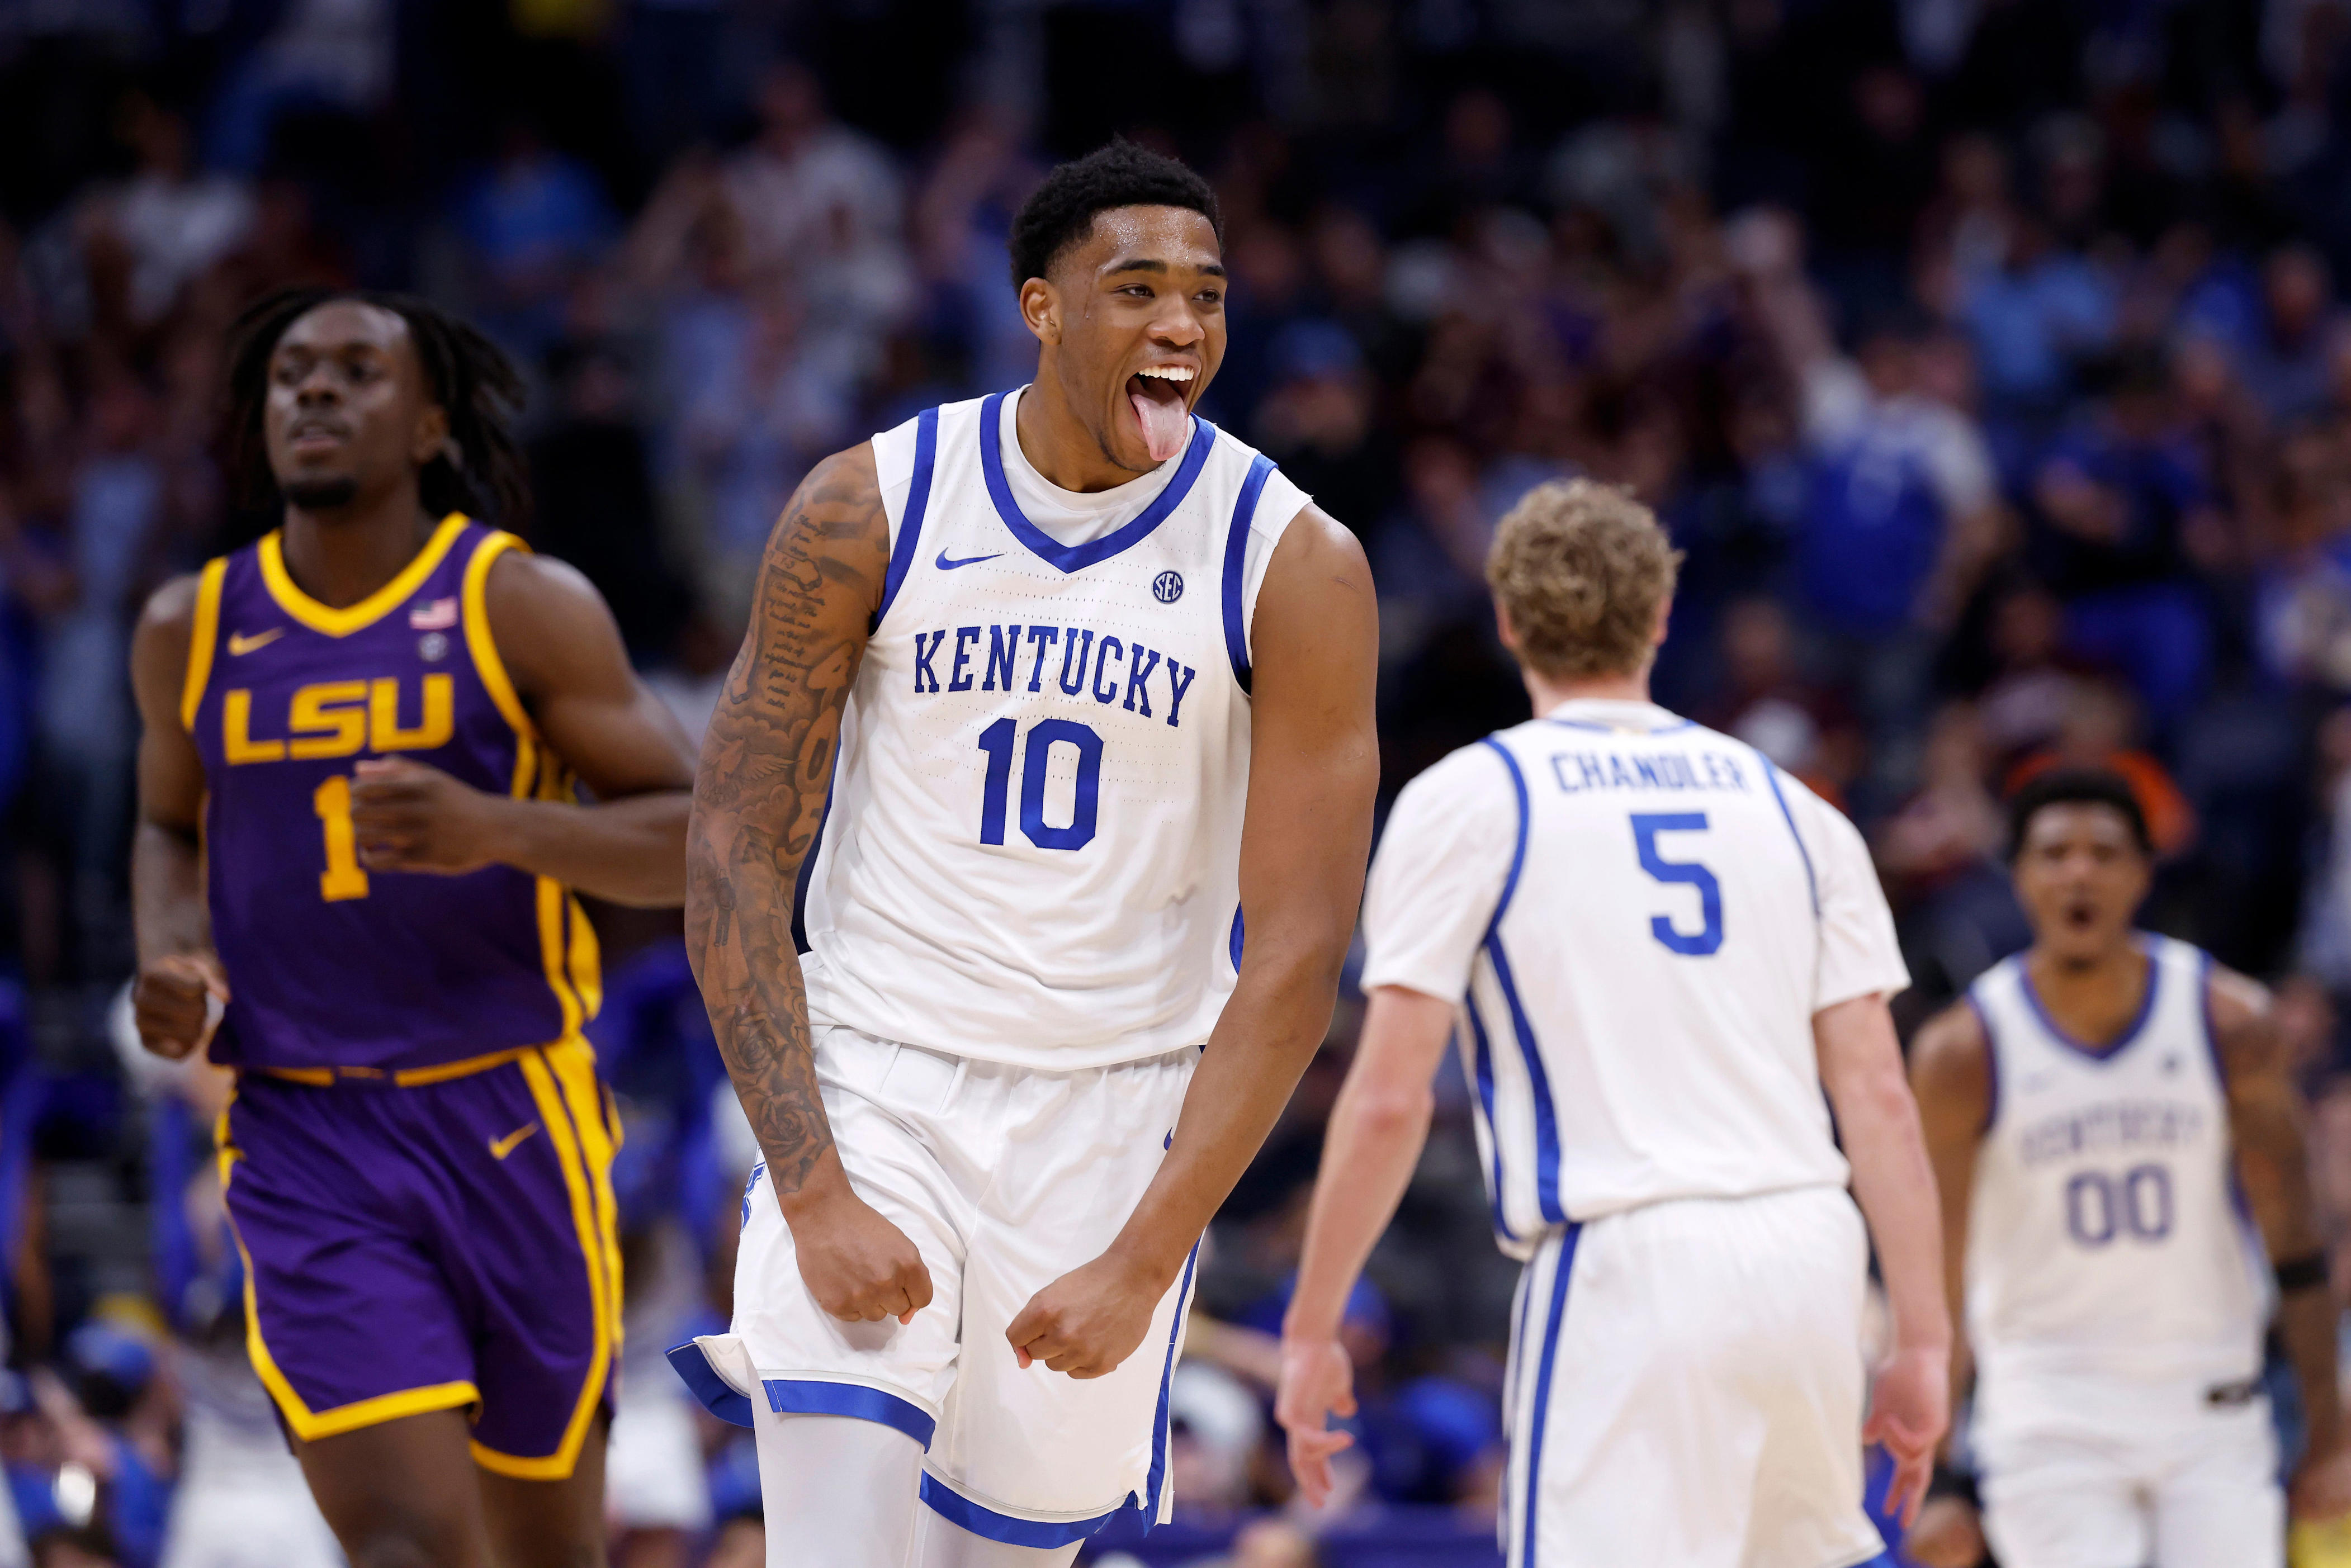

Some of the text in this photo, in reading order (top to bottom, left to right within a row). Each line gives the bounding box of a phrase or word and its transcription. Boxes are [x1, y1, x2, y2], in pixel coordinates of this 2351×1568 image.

[1154, 572, 1182, 601] SEC
[224, 673, 454, 766] LSU
[915, 624, 1196, 728] KENTUCKY
[978, 717, 1104, 851] 10
[1549, 751, 1750, 794] CHANDLER
[314, 775, 369, 902] 1
[1629, 811, 1724, 957] 5
[2065, 1163, 2174, 1249] 00
